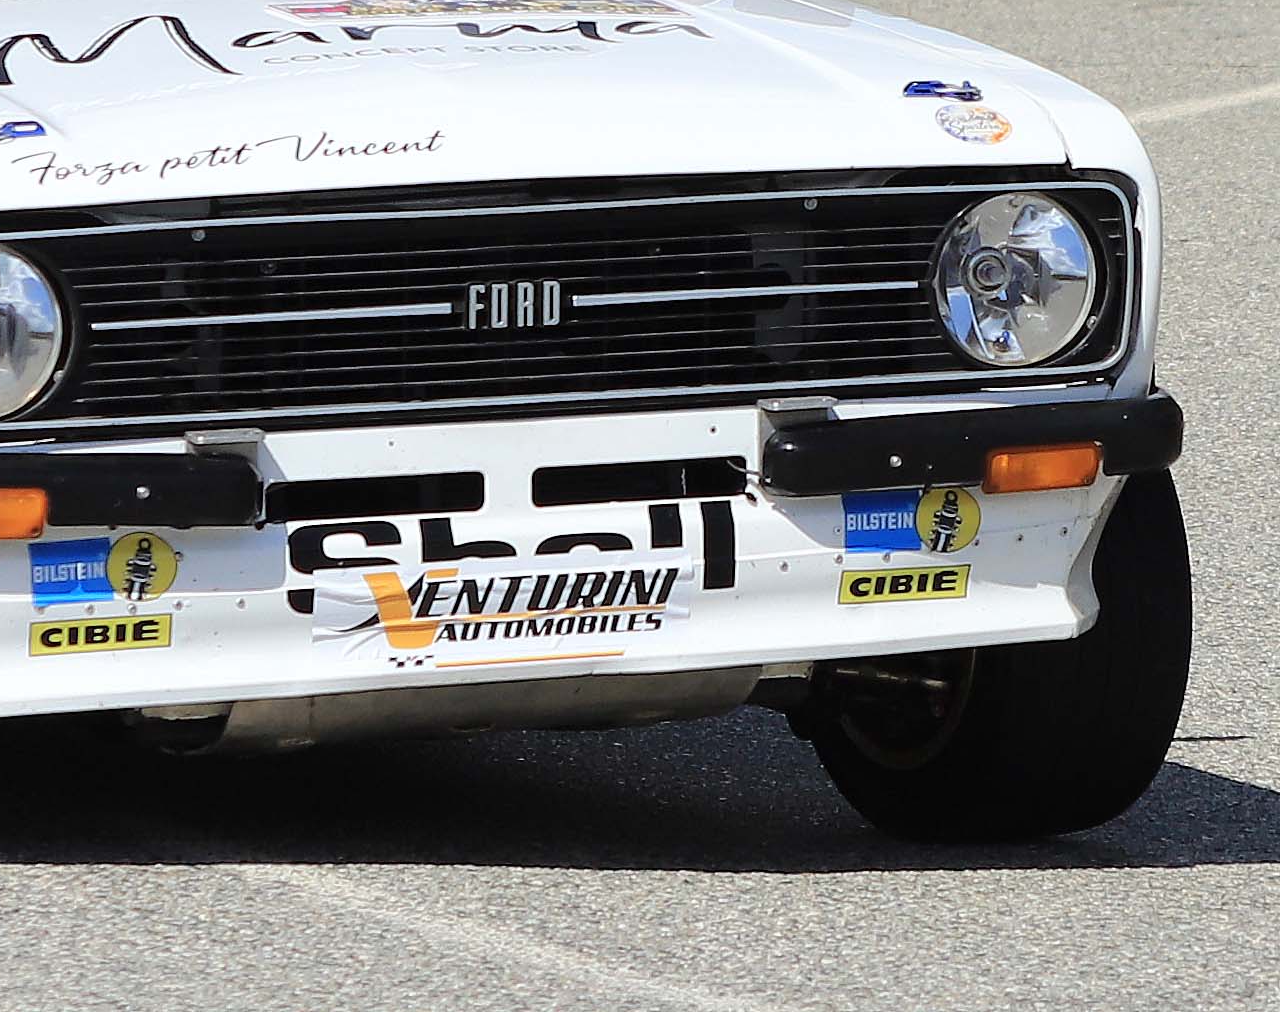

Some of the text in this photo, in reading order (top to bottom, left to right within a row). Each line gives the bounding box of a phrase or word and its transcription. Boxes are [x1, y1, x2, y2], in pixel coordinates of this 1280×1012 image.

[263, 43, 592, 65] CONCEPT STORE
[12, 130, 447, 186] Forza petit Vincent
[468, 280, 561, 330] FORD
[847, 512, 914, 532] BILSTEIN
[32, 562, 106, 584] BILSTEIN
[363, 567, 680, 650] VENTURINI
[436, 612, 663, 645] AUTOMOBILES
